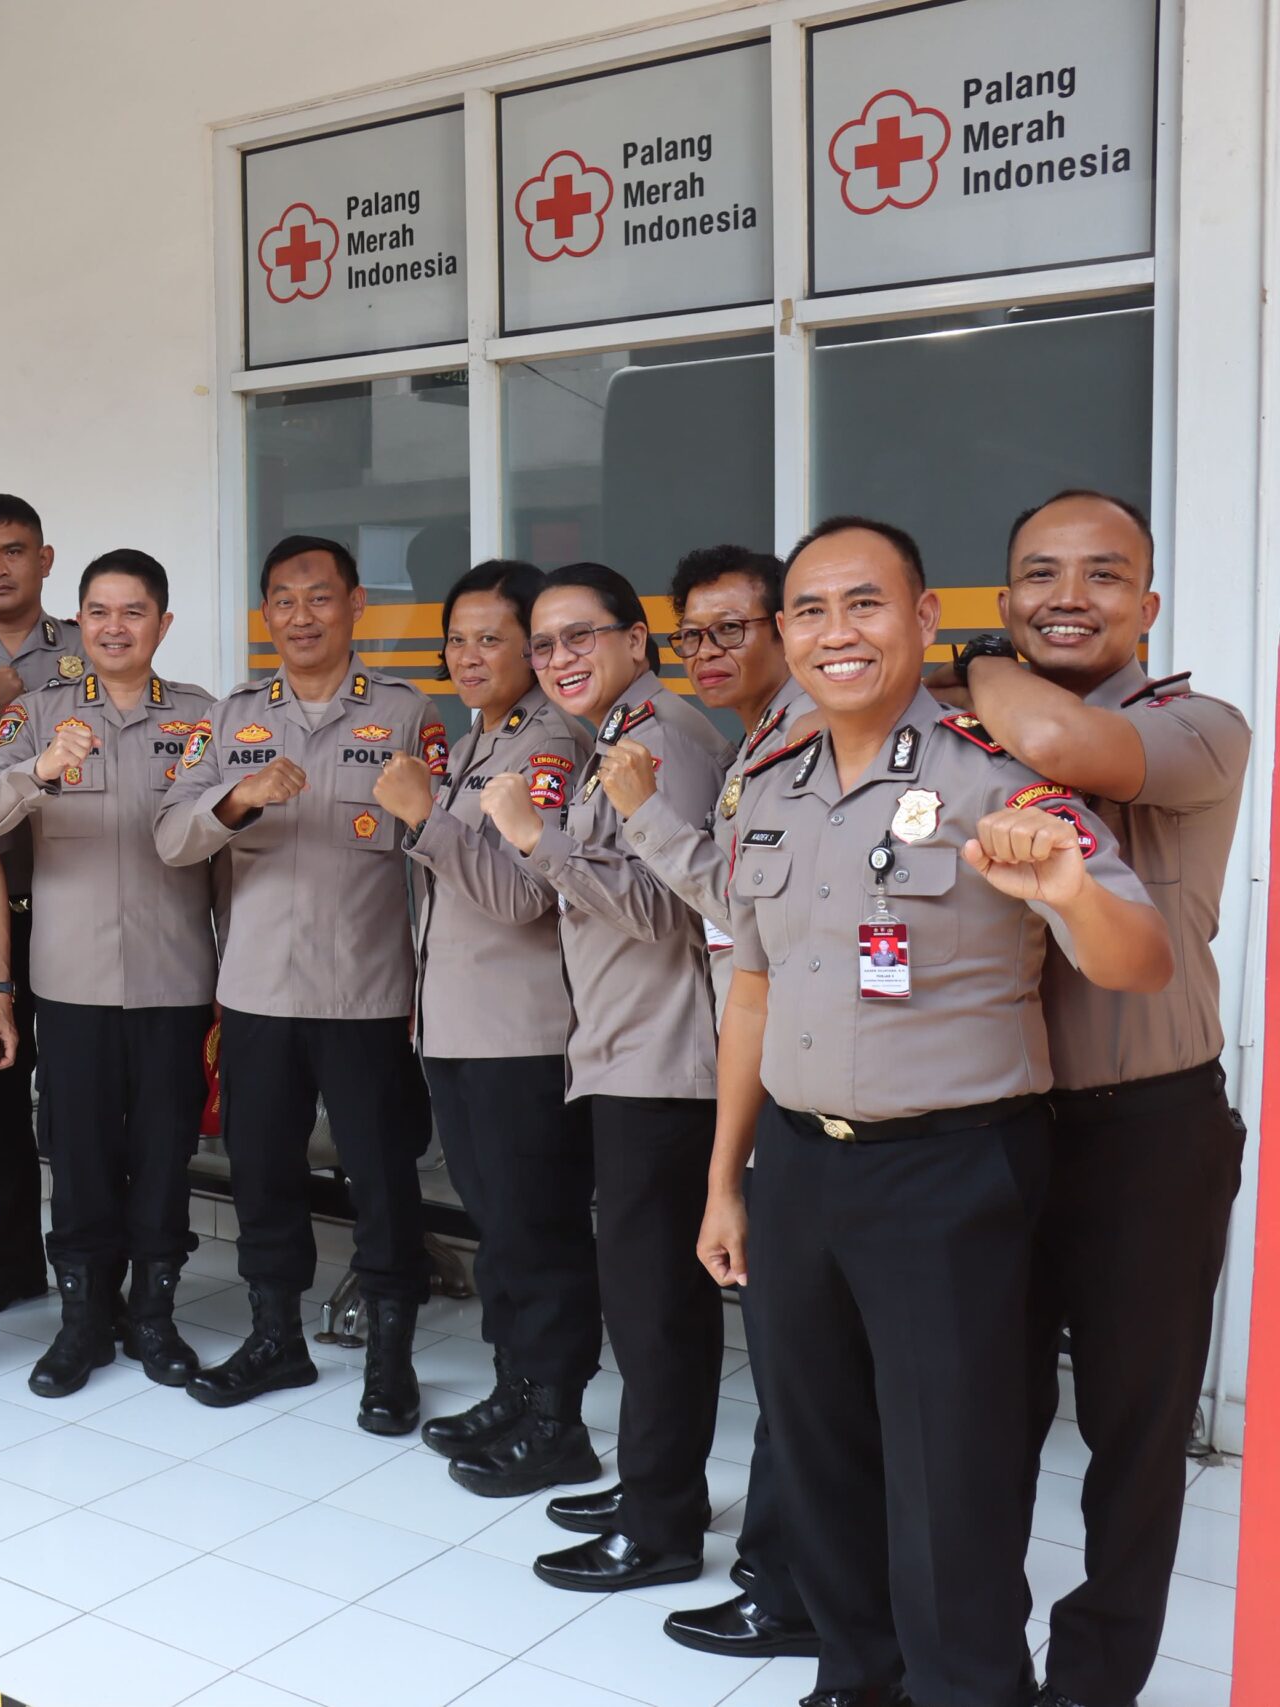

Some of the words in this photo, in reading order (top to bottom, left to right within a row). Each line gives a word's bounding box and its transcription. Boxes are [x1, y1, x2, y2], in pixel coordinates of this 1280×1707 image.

[963, 66, 1076, 109] Palang
[963, 109, 1065, 154] Merah
[623, 133, 712, 169] Palang
[963, 143, 1131, 196] Indonesia
[346, 189, 420, 221] Palang
[623, 171, 705, 209] Merah
[347, 223, 414, 257] Merah
[624, 203, 757, 246] Indonesia
[347, 255, 458, 290] Indonesia
[228, 749, 277, 765] ASEP
[343, 749, 394, 765] POLR
[533, 756, 570, 768] LEMDIKLAT
[1011, 785, 1064, 809] LEMDIKLAT
